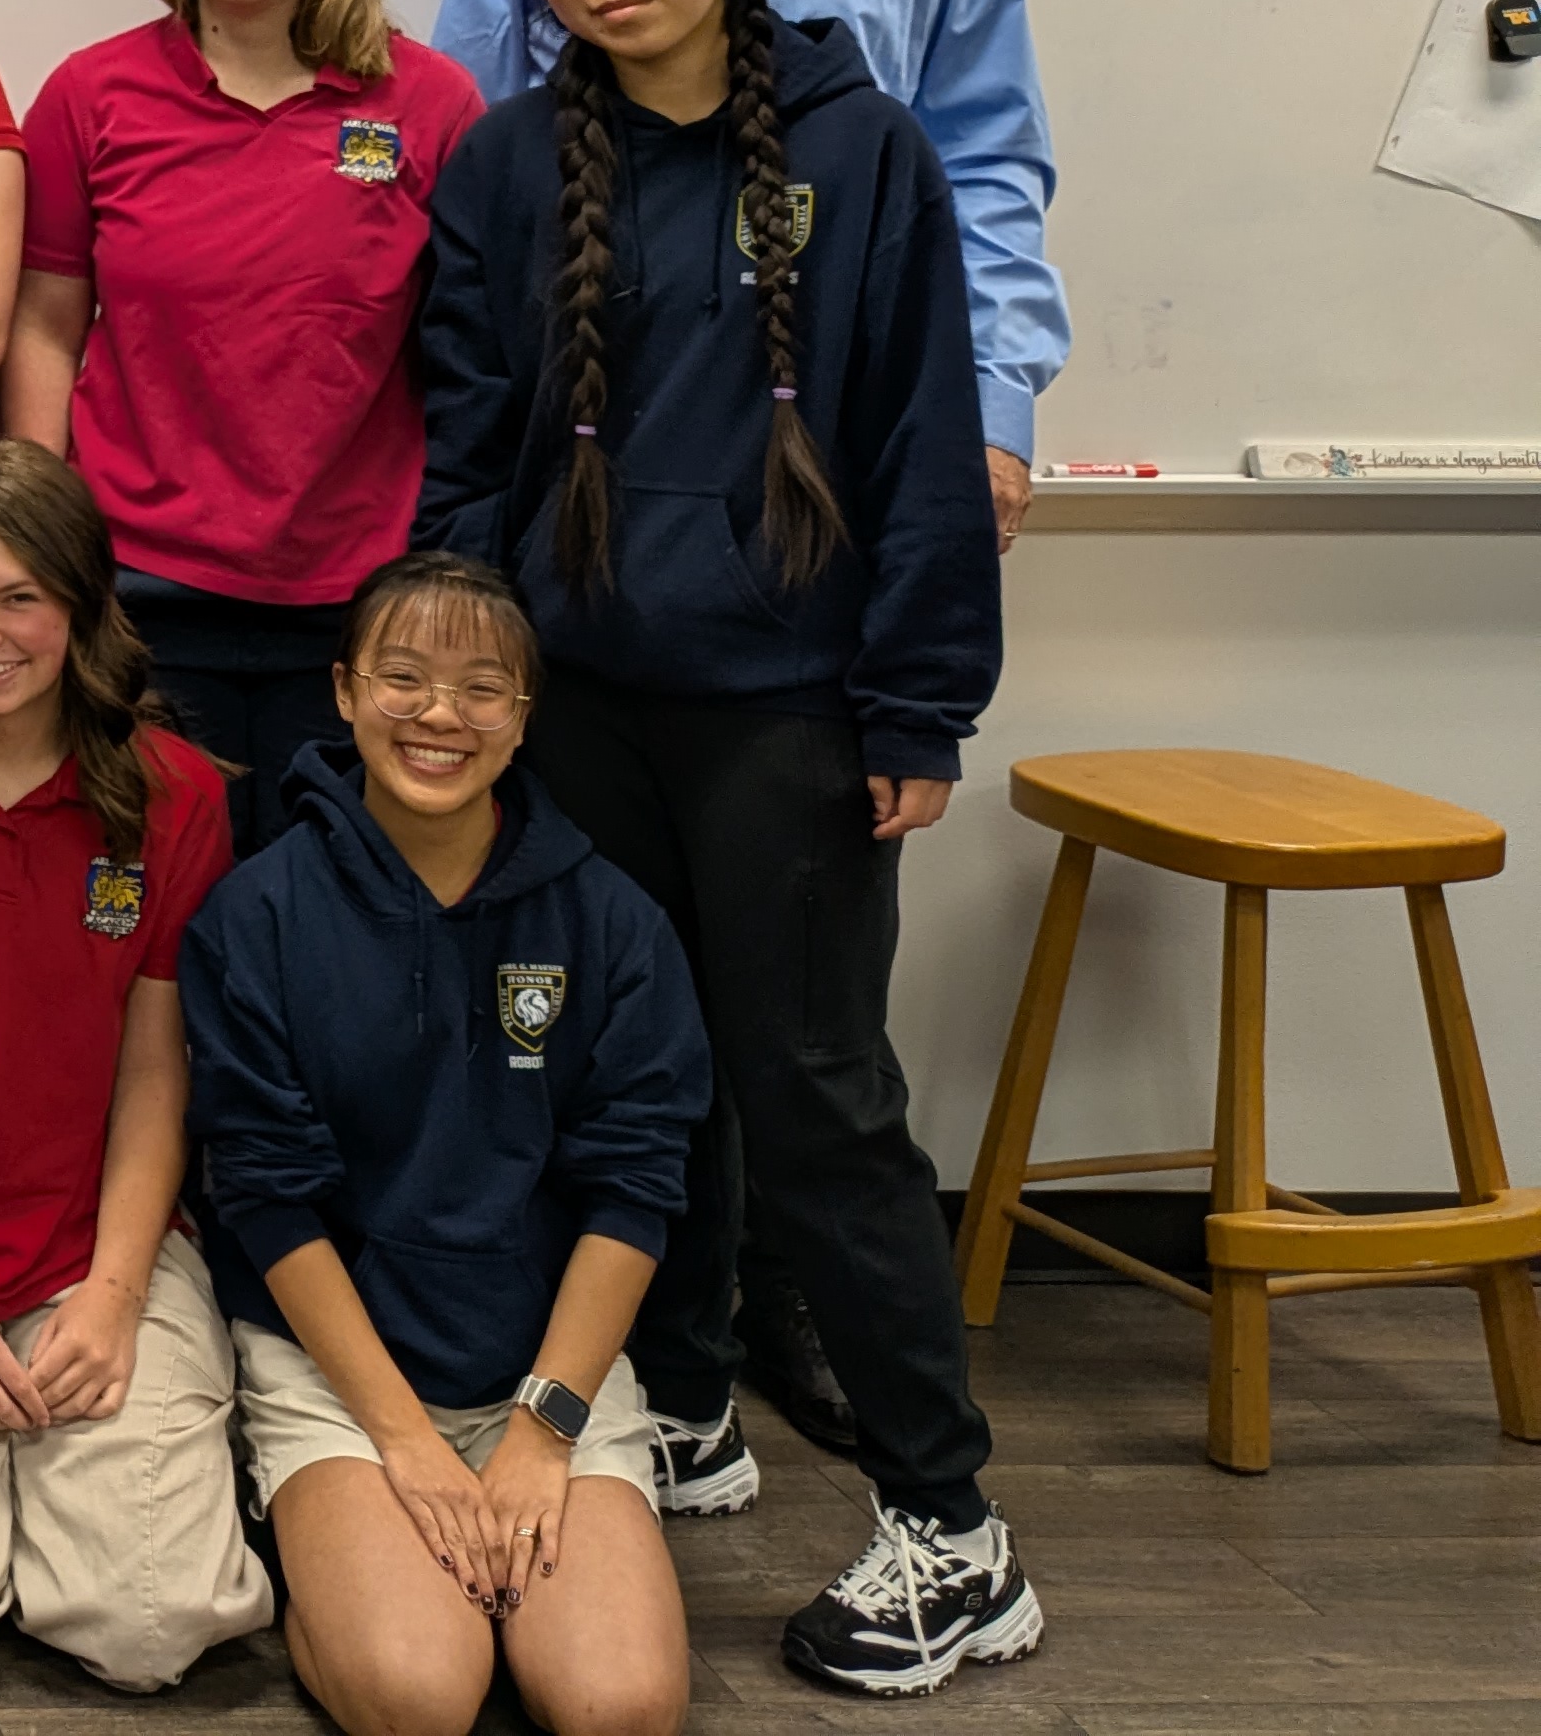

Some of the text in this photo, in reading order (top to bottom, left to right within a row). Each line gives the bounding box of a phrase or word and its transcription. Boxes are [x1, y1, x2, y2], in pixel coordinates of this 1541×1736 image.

[1371, 448, 1430, 466] Kindness
[1435, 453, 1447, 466] is
[1452, 451, 1494, 474] always
[507, 976, 553, 984] HONOR
